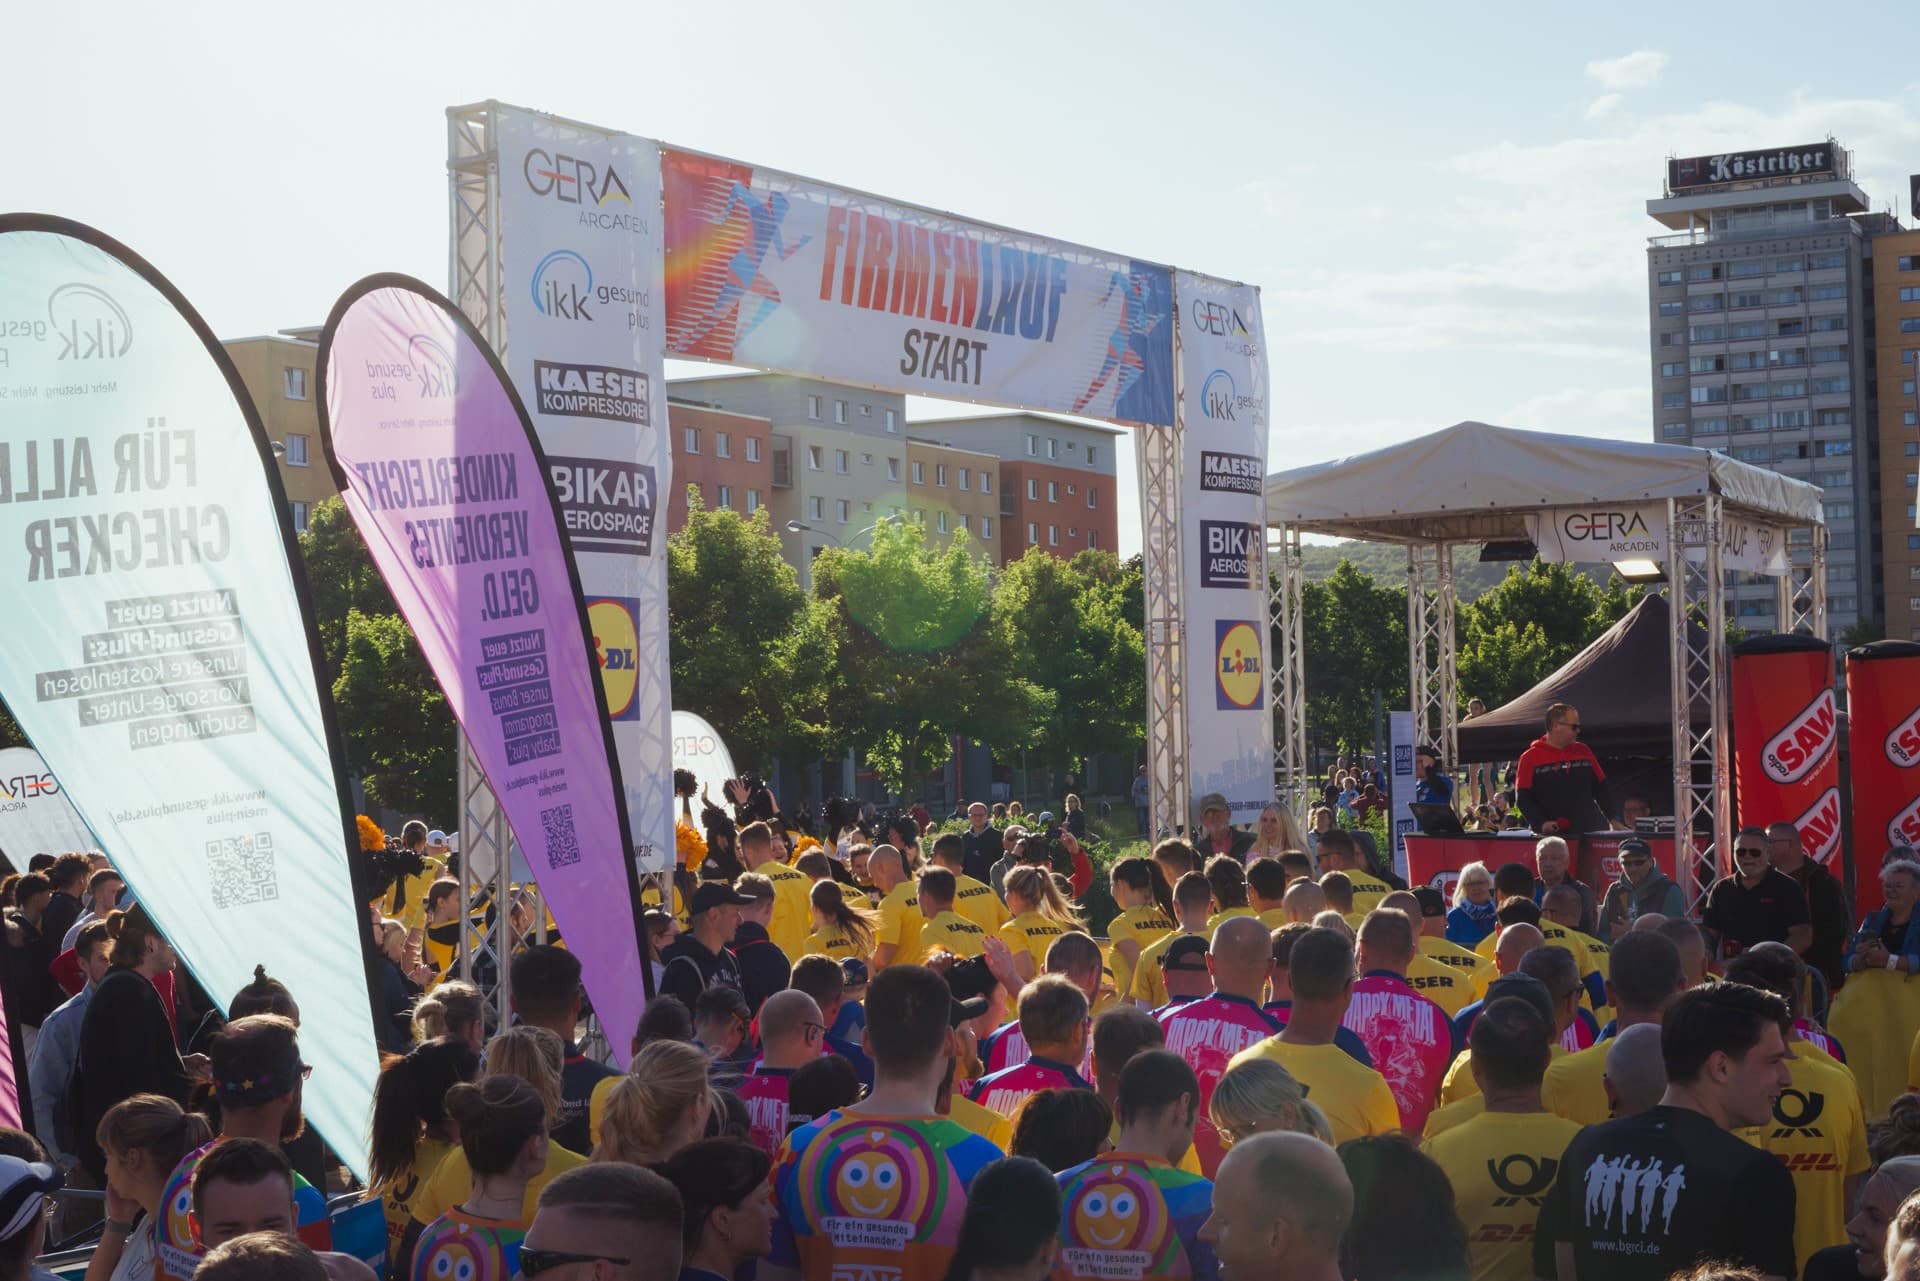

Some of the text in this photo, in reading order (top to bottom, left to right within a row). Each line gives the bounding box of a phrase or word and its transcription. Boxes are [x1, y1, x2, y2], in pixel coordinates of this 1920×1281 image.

[524, 148, 633, 208] GERA
[1709, 149, 1824, 182] Köstritzer
[578, 211, 648, 234] ARCADEN
[818, 205, 1067, 343] FIRMENLAUF
[545, 280, 649, 321] ikk gesund
[1192, 298, 1250, 340] GERA
[900, 327, 988, 386] START
[540, 367, 647, 401] KAESER
[1210, 391, 1236, 421] ikk
[550, 465, 650, 509] BIKAR
[565, 509, 650, 535] EROSPACE
[1564, 511, 1649, 541] GERA
[1609, 541, 1659, 552] ARCADEN
[1776, 695, 1836, 771] SAW
[1768, 753, 1790, 777] radio
[1801, 795, 1840, 855] AW
[1407, 976, 1454, 989] ESER
[1478, 1224, 1536, 1242] DH
[1592, 1239, 1660, 1255] www.bgrci.de
